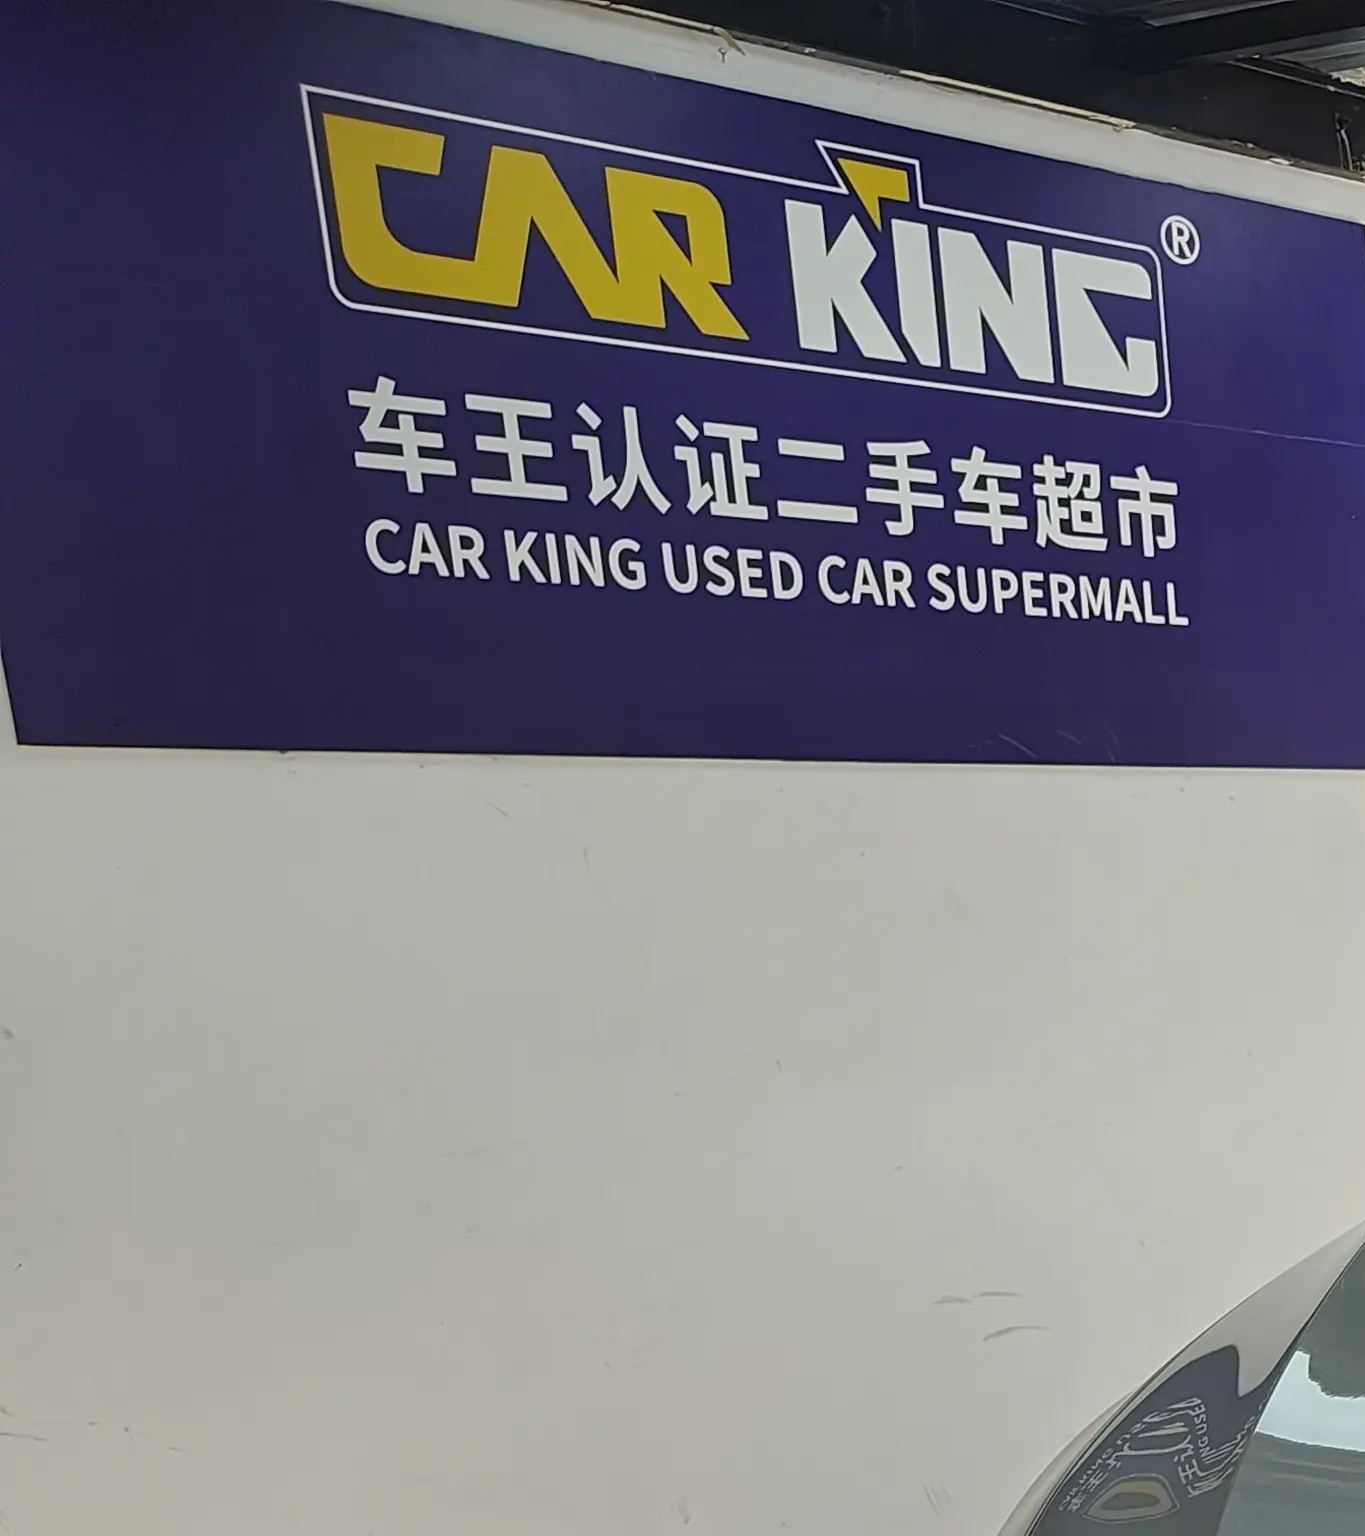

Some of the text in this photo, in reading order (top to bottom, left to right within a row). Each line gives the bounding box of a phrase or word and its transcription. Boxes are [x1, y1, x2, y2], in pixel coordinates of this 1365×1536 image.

[322, 113, 750, 340] CAR
[784, 157, 1159, 398] KING
[347, 375, 1179, 558] 车王认证二手车超市
[364, 517, 1191, 627] CAR KING USED CAR SUPERMALL
